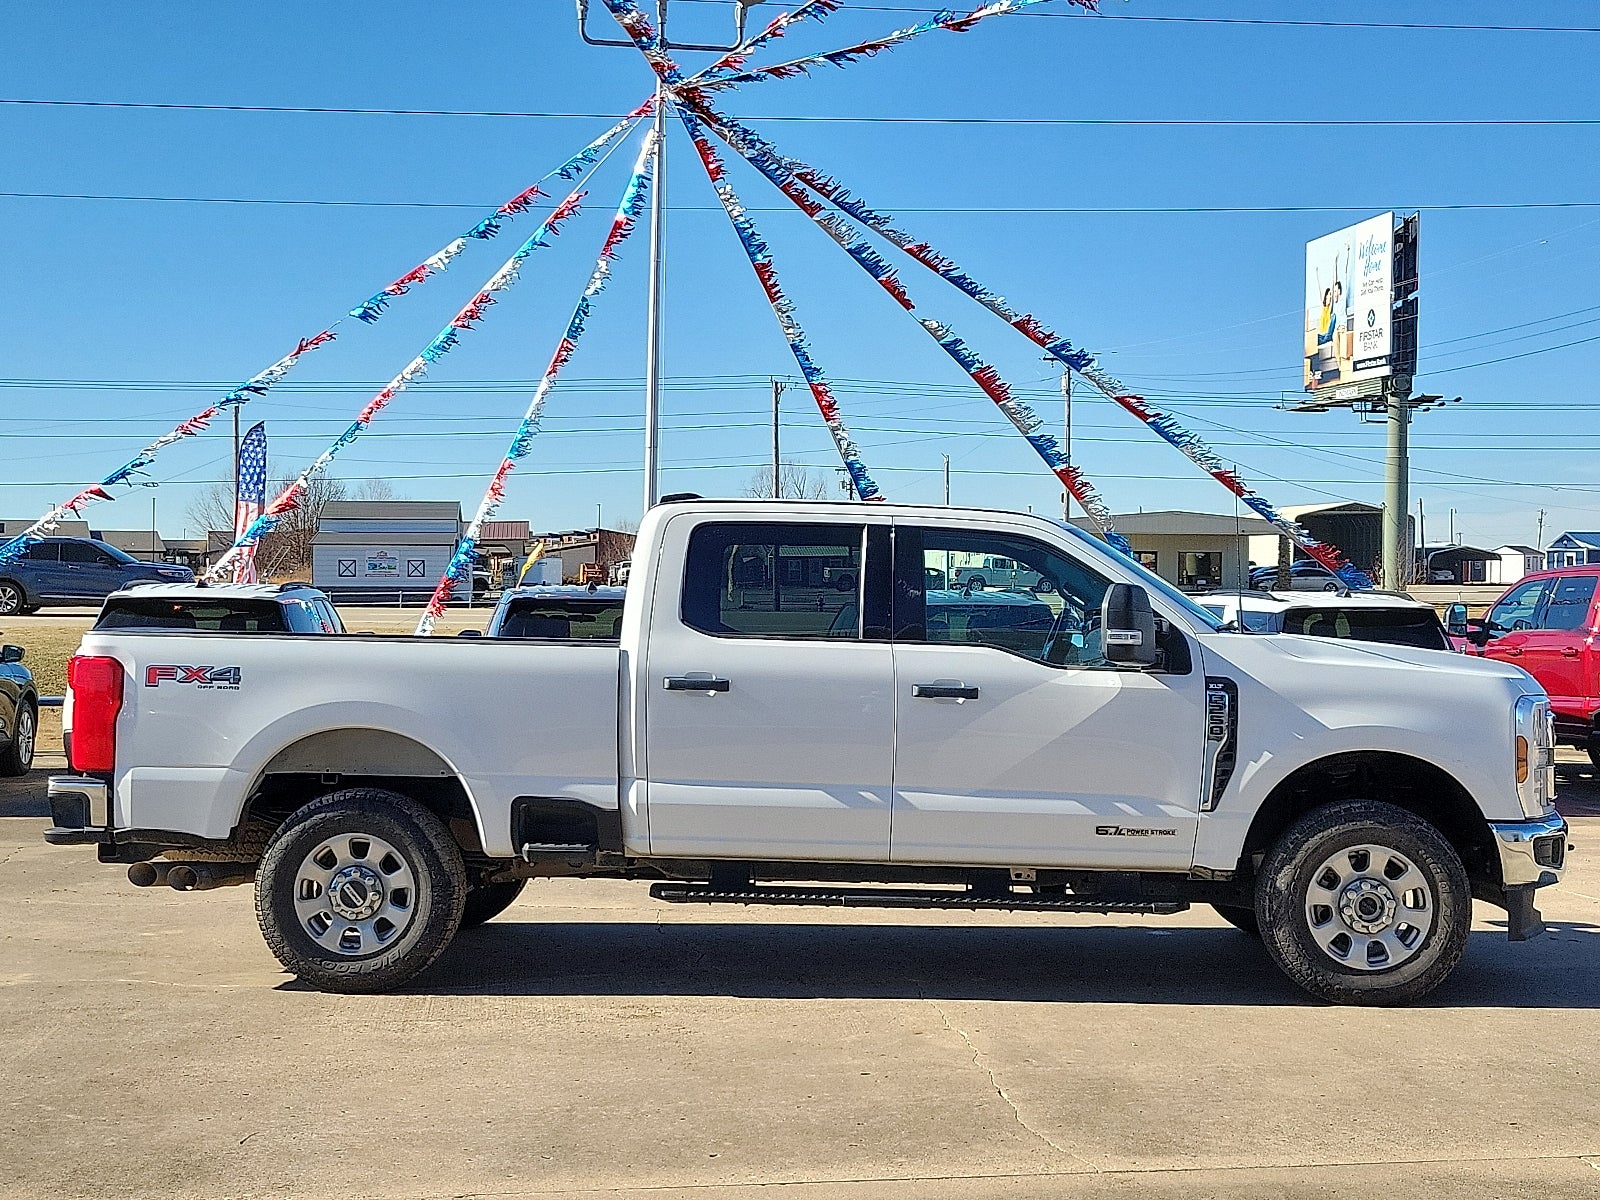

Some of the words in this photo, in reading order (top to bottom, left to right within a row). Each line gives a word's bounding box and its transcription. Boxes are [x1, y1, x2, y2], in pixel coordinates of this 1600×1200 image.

[1359, 234, 1387, 260] Welcome
[1364, 257, 1381, 277] Home
[145, 664, 241, 687] FX4
[1126, 828, 1150, 836] POWER
[1150, 828, 1176, 836] STROKE
